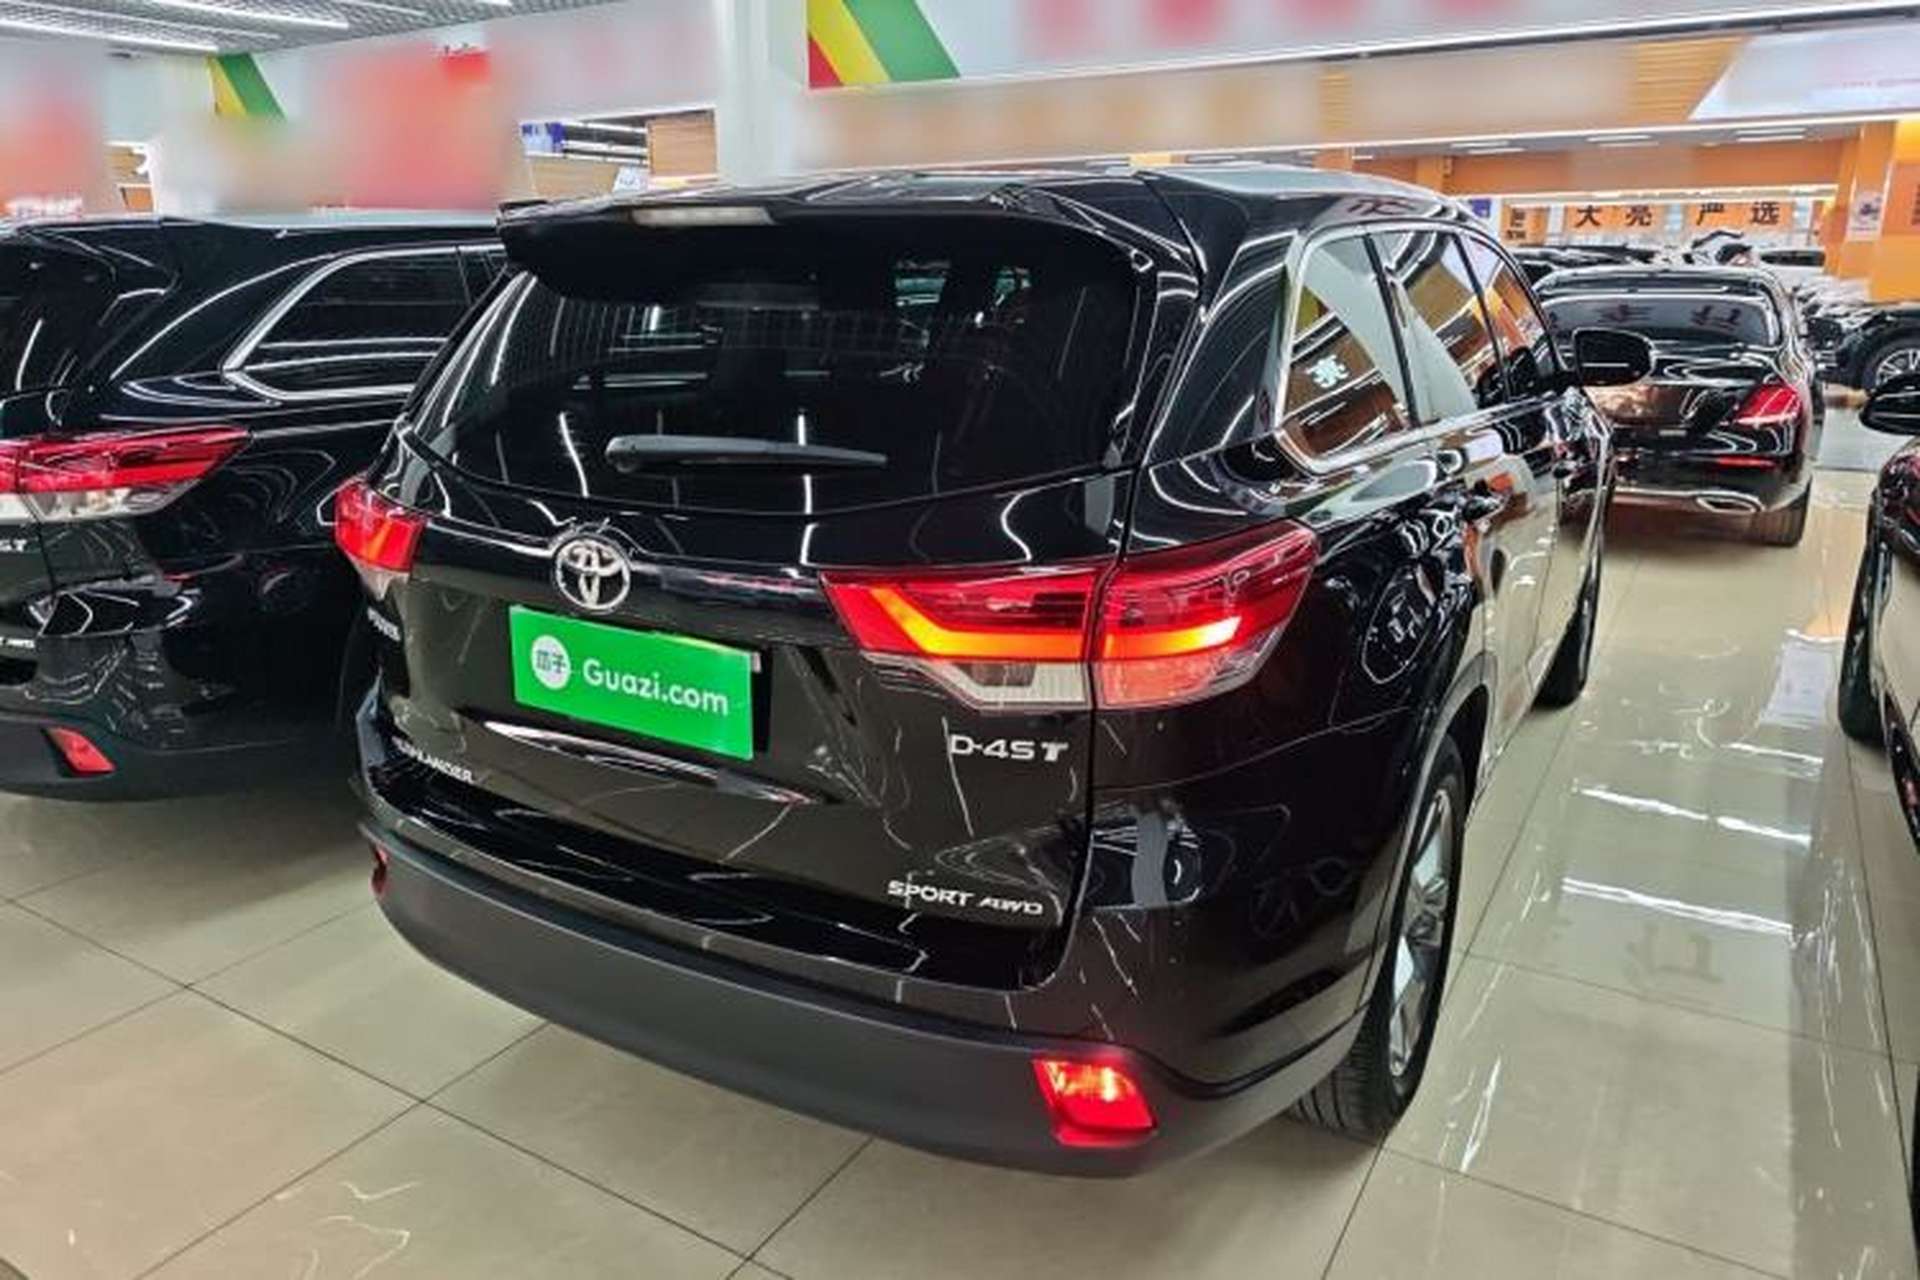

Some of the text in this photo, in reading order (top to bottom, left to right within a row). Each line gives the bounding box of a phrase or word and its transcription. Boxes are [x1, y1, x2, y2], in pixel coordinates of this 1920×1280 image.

[582, 657, 729, 716] Guazi.com
[887, 879, 1044, 915] SPORT AWD
